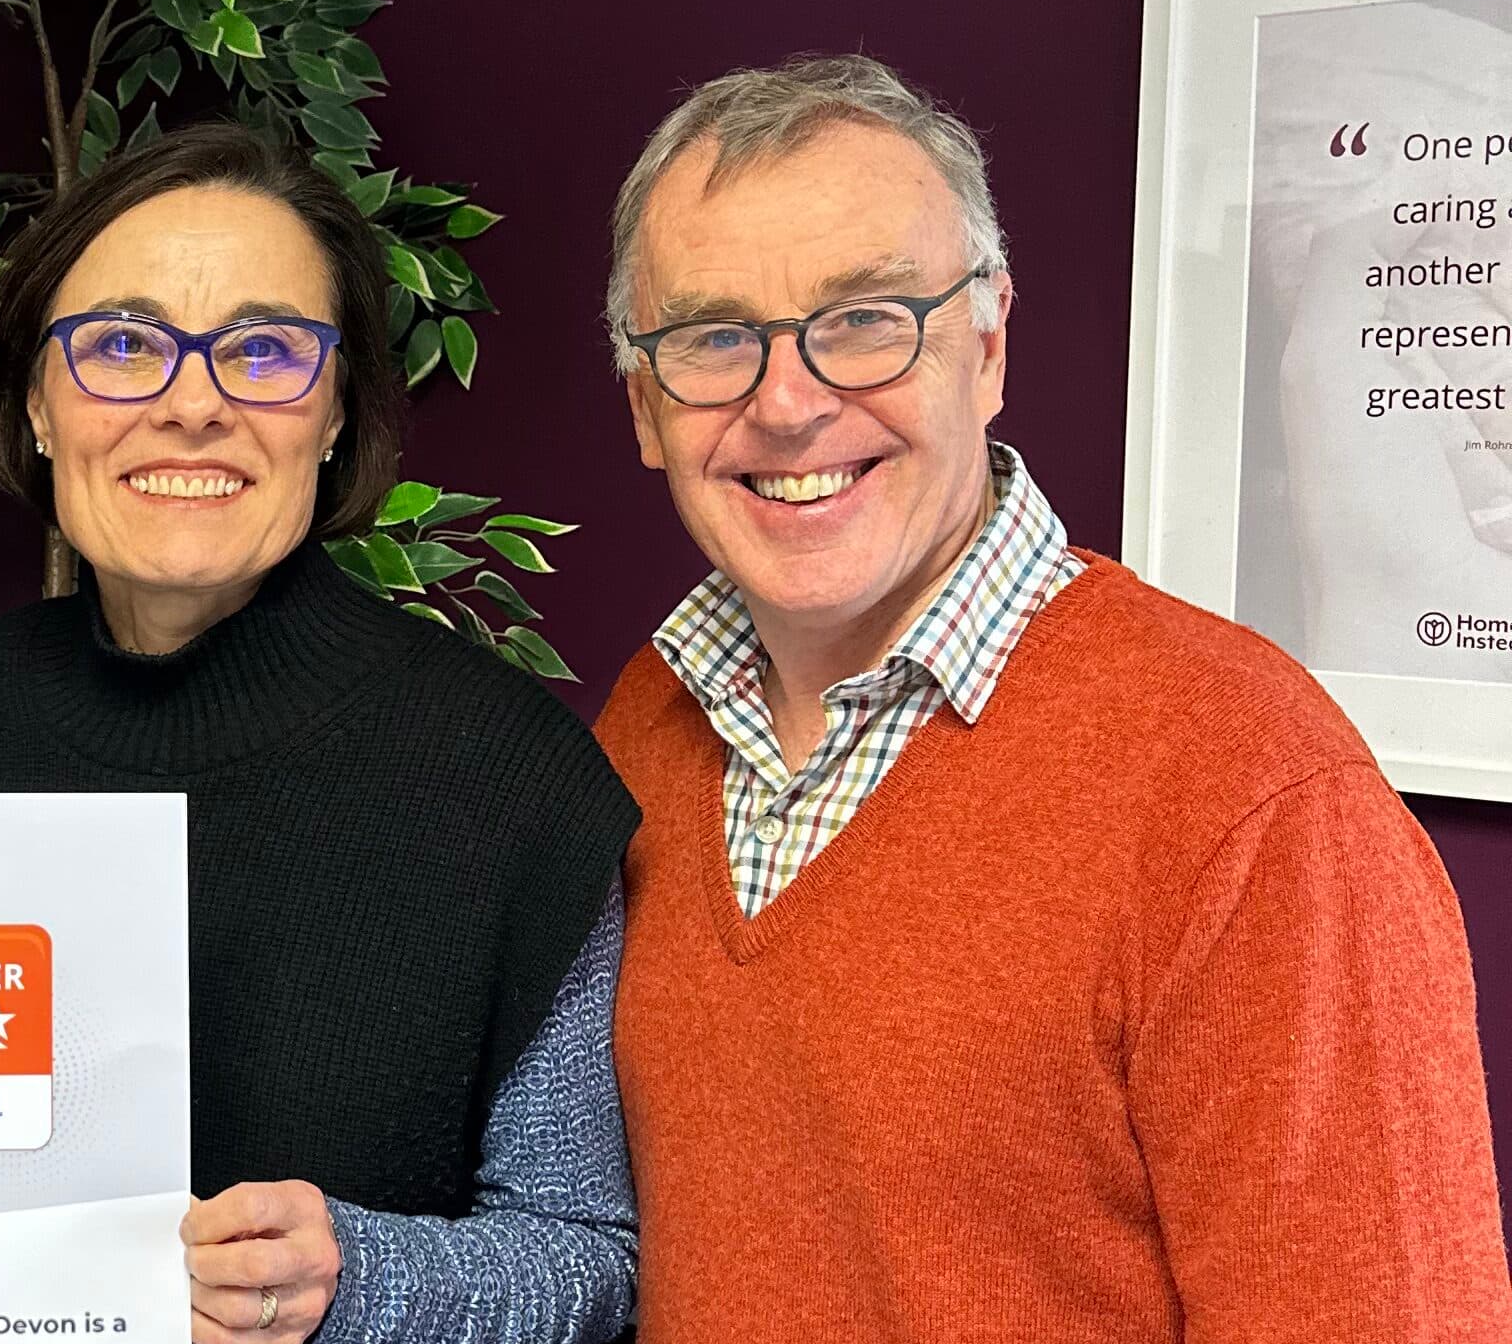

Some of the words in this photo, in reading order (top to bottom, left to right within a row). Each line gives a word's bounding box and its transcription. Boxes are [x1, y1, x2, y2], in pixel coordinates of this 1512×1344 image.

[1403, 133, 1473, 162] One
[1484, 134, 1512, 166] p
[1393, 193, 1497, 229] caring
[1365, 256, 1501, 288] another
[1361, 325, 1512, 356] represen
[1366, 384, 1506, 417] greatest
[1463, 440, 1482, 452] Jim
[1457, 614, 1512, 633] Hom
[85, 1312, 105, 1334] is
[112, 1316, 127, 1333] a
